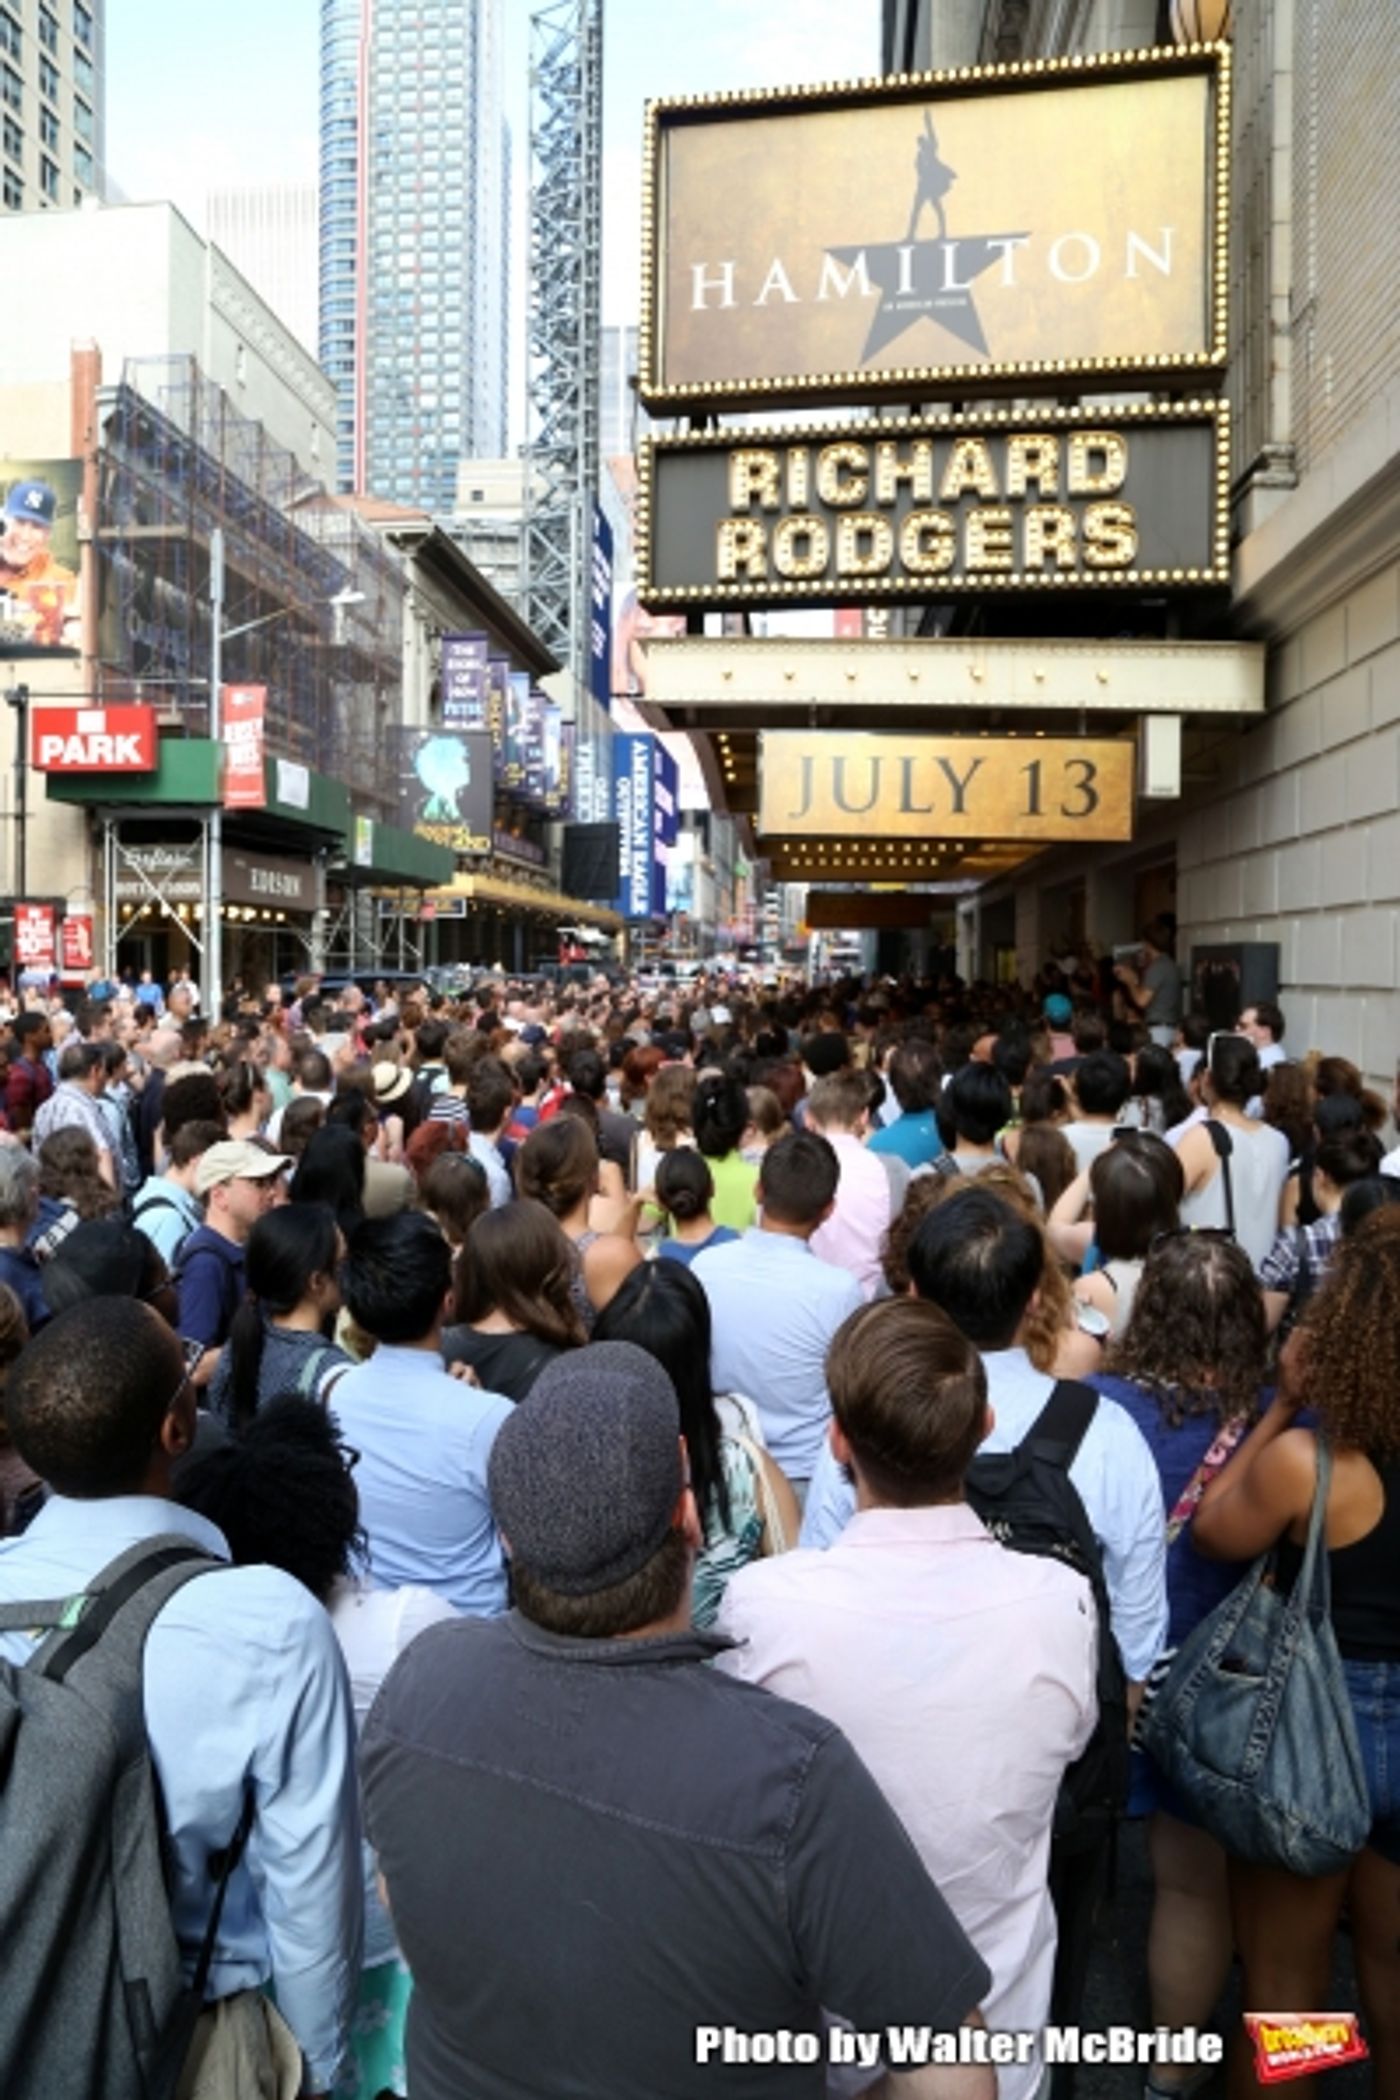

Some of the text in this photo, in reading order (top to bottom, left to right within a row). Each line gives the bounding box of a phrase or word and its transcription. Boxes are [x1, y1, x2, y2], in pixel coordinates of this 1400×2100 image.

[691, 226, 1176, 311] HAMILTON
[728, 431, 1129, 513] RICHARD
[716, 502, 1138, 580] RODGERS
[40, 735, 142, 764] PARK
[788, 756, 1099, 818] JULY 13
